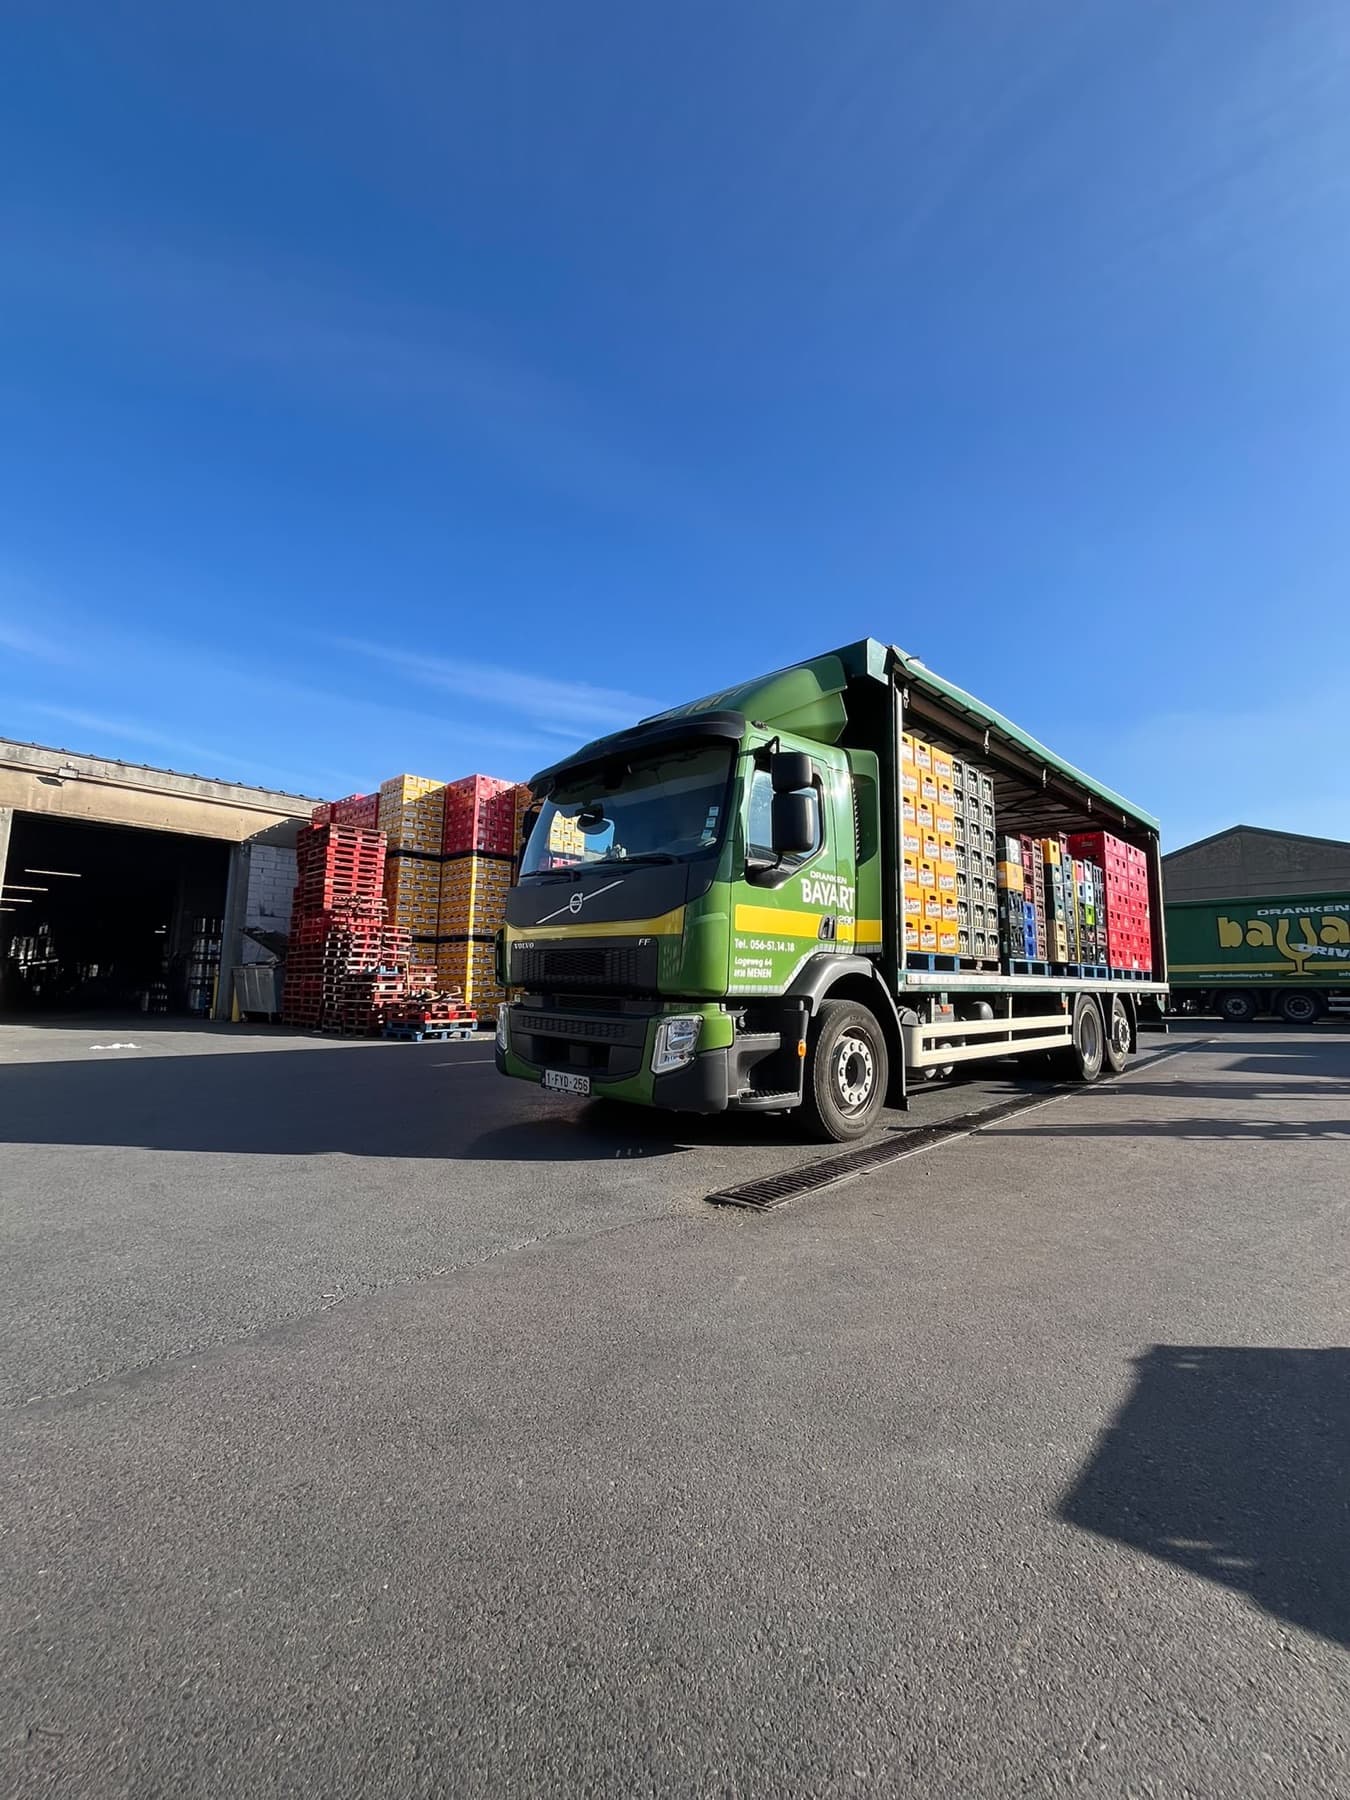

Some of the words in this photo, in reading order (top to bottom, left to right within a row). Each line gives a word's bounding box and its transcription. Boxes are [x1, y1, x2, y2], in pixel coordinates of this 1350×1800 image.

[810, 870, 847, 885] DRANKEN
[801, 878, 855, 912] BAYART
[1256, 904, 1350, 916] DRANKEN
[514, 942, 535, 950] VOLVO
[734, 938, 748, 949] Tel.
